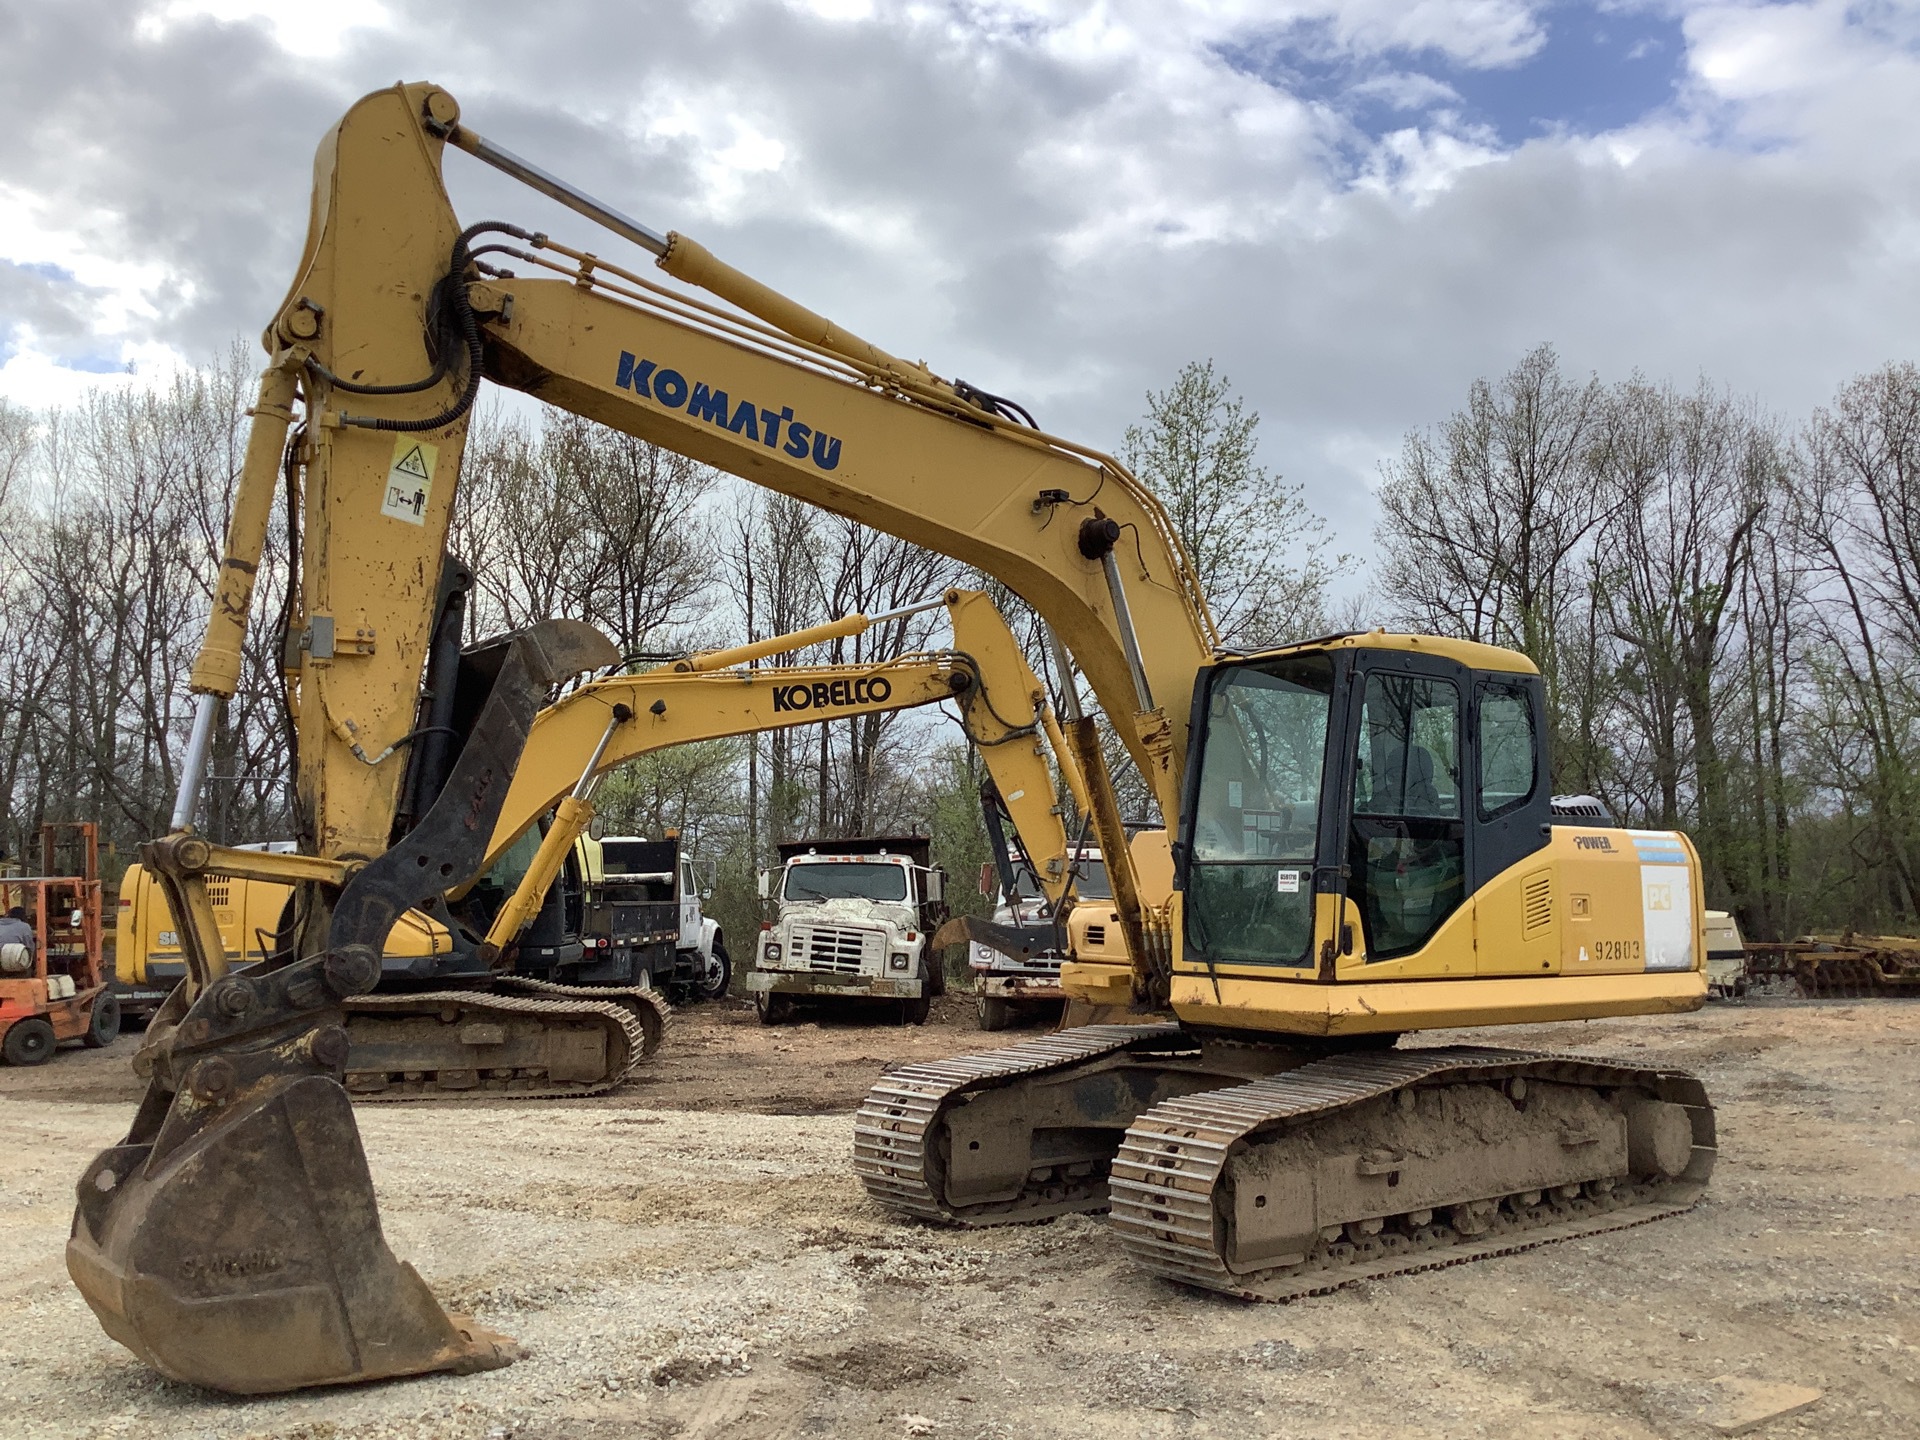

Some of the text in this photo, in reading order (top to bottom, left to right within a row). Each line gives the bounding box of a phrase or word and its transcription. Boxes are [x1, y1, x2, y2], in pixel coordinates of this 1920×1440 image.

[615, 350, 842, 470] KOMATSU
[773, 676, 892, 712] KOBELCO
[1573, 836, 1612, 850] POWER
[1595, 940, 1640, 961] 92803
